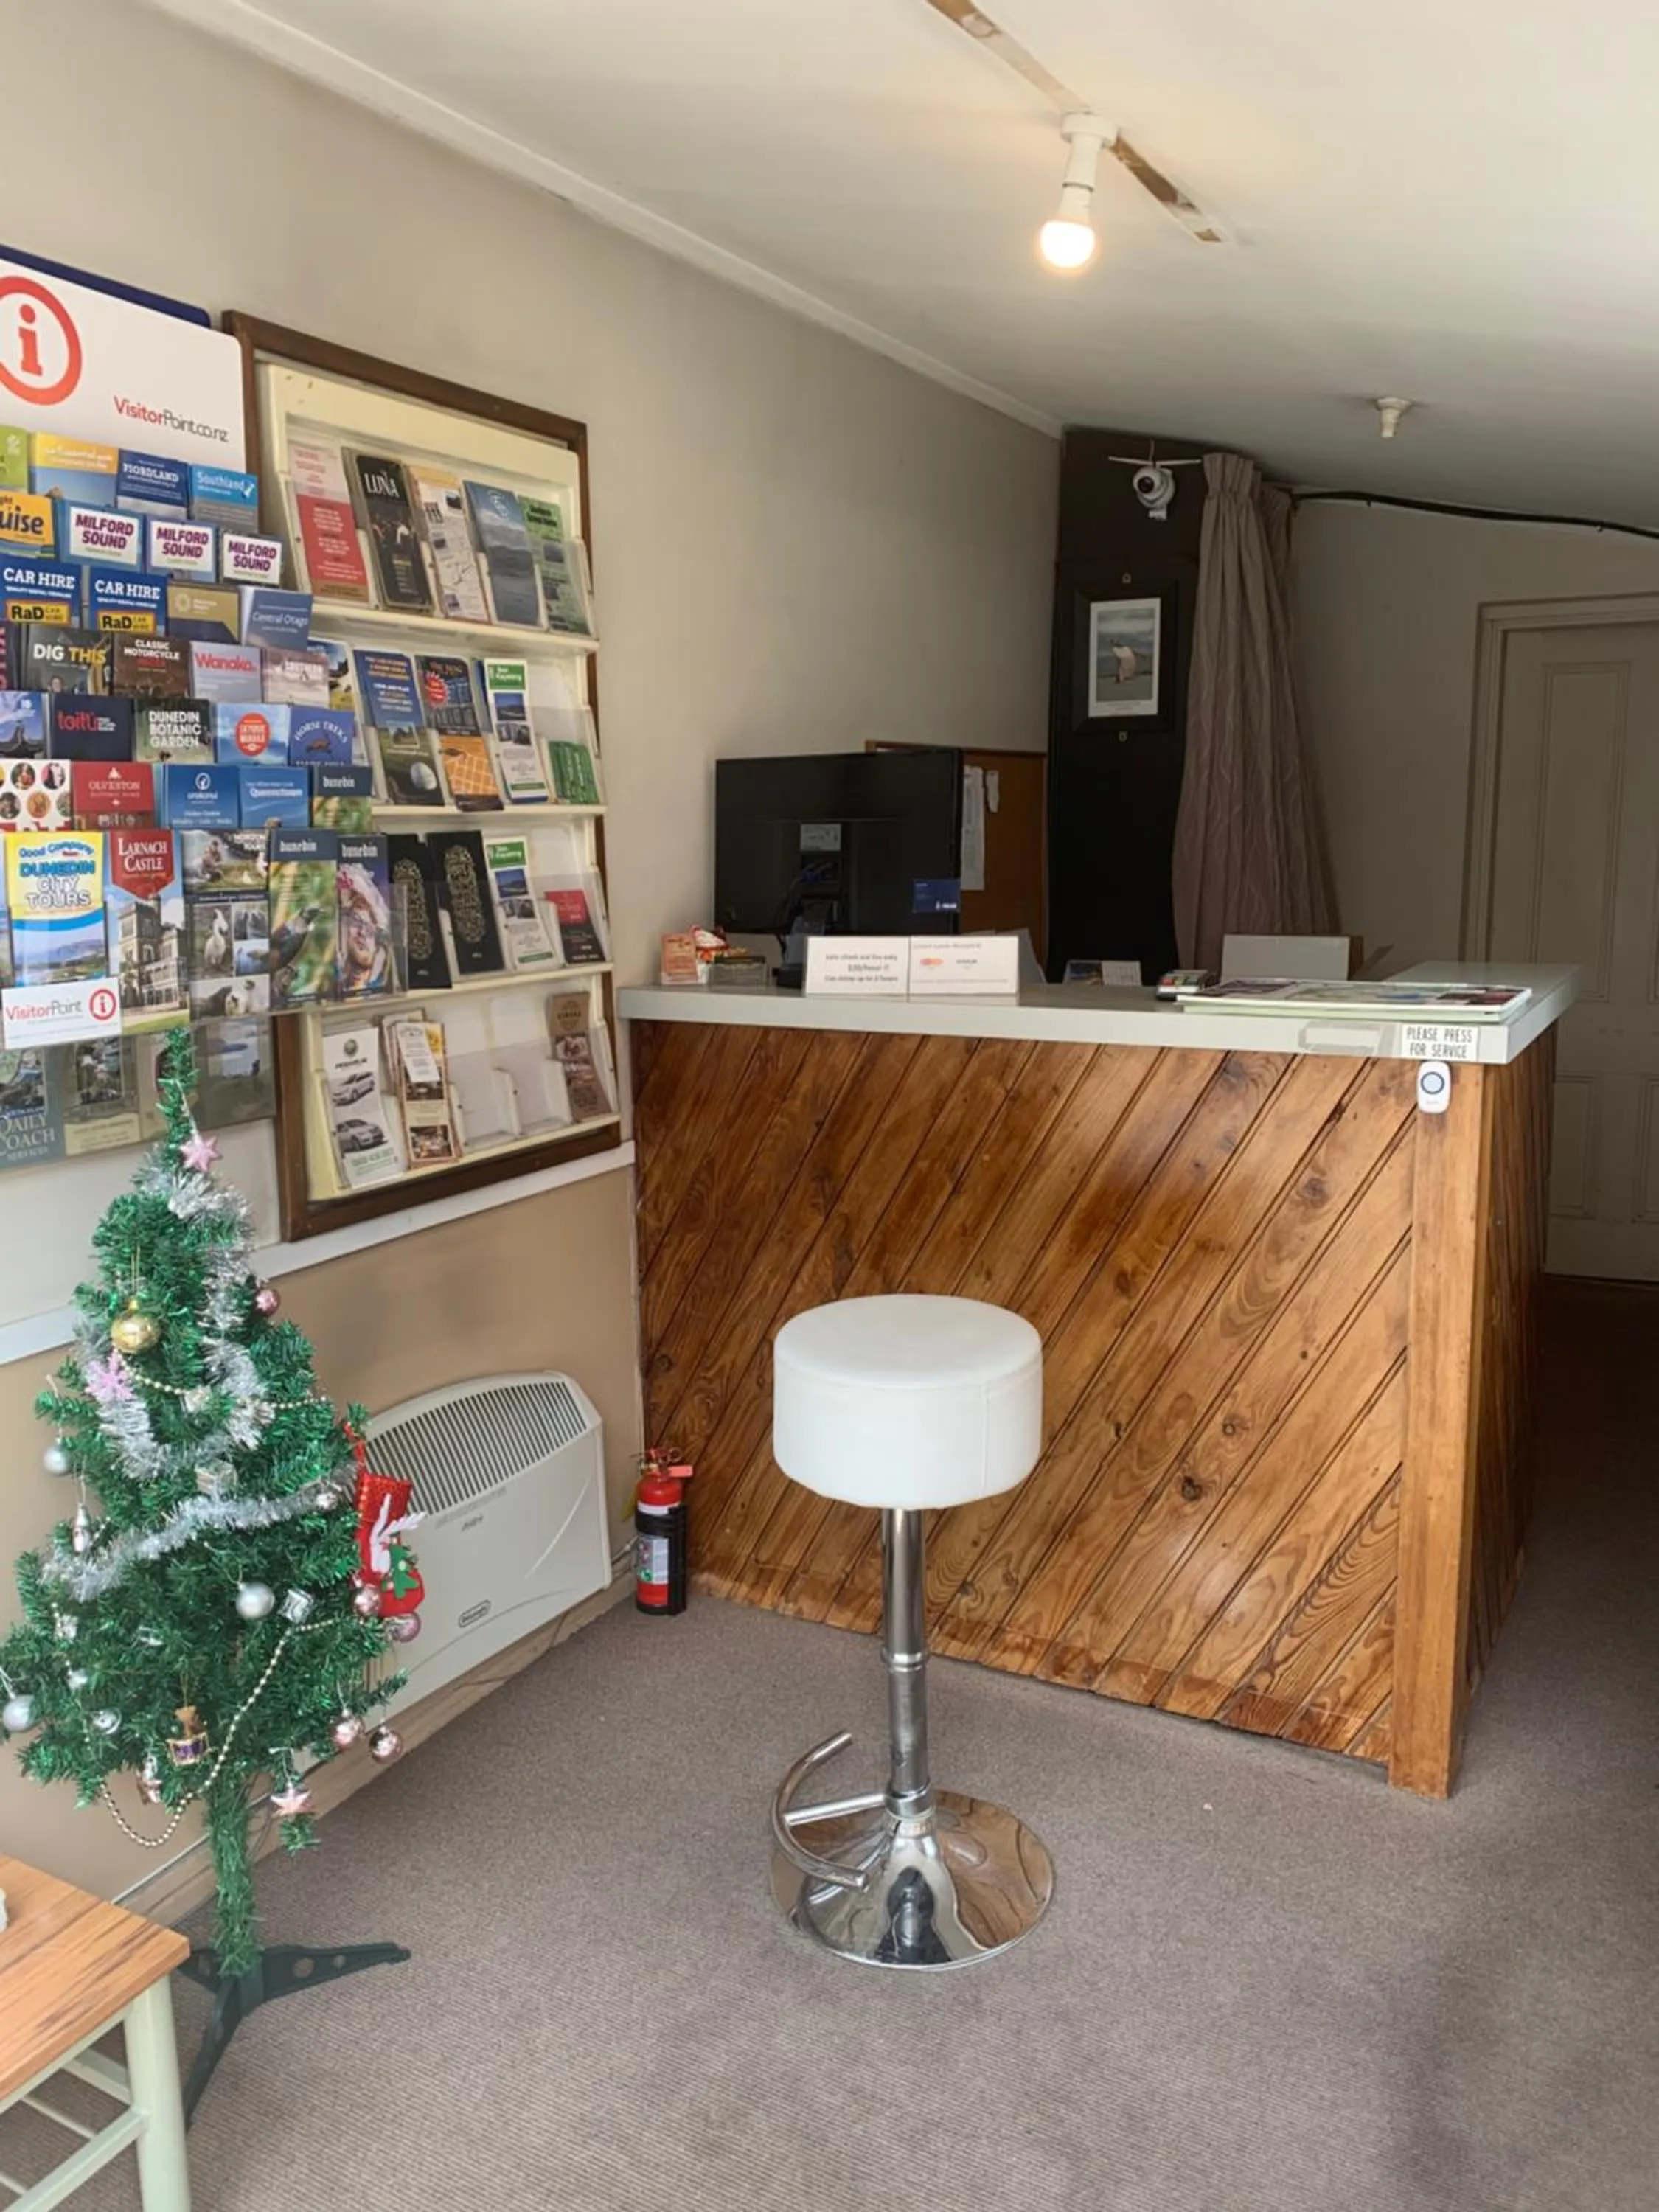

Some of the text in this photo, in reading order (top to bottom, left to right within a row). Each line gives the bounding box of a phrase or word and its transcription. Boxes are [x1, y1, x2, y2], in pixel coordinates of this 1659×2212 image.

[75, 514, 134, 536] MILFORD
[82, 530, 127, 549] SOUND
[156, 527, 209, 546] MILFORD
[162, 543, 204, 558] SOUND
[229, 541, 277, 559] MILFORD
[234, 555, 271, 572] SOUND
[4, 568, 75, 589] CAR HIRE
[95, 580, 161, 599] CAR HIRE
[11, 605, 44, 620] RaD
[102, 616, 131, 630] RaD
[135, 639, 170, 650] CLASSIC
[33, 644, 107, 664] DIG THIS
[123, 647, 181, 661] MOTORCYCLE
[150, 710, 200, 723] DUNEDIN
[150, 723, 201, 735] BOTANIC
[150, 737, 198, 748] GARDEN
[118, 838, 168, 856] LARNACH
[20, 860, 96, 877] DUNEDIN
[124, 857, 165, 872] CASTLE
[37, 876, 80, 892] CITY
[27, 891, 91, 909] TOURS
[1406, 1026, 1472, 1043] PLEASE PRESS
[1410, 1043, 1467, 1059] FOR SERVICE
